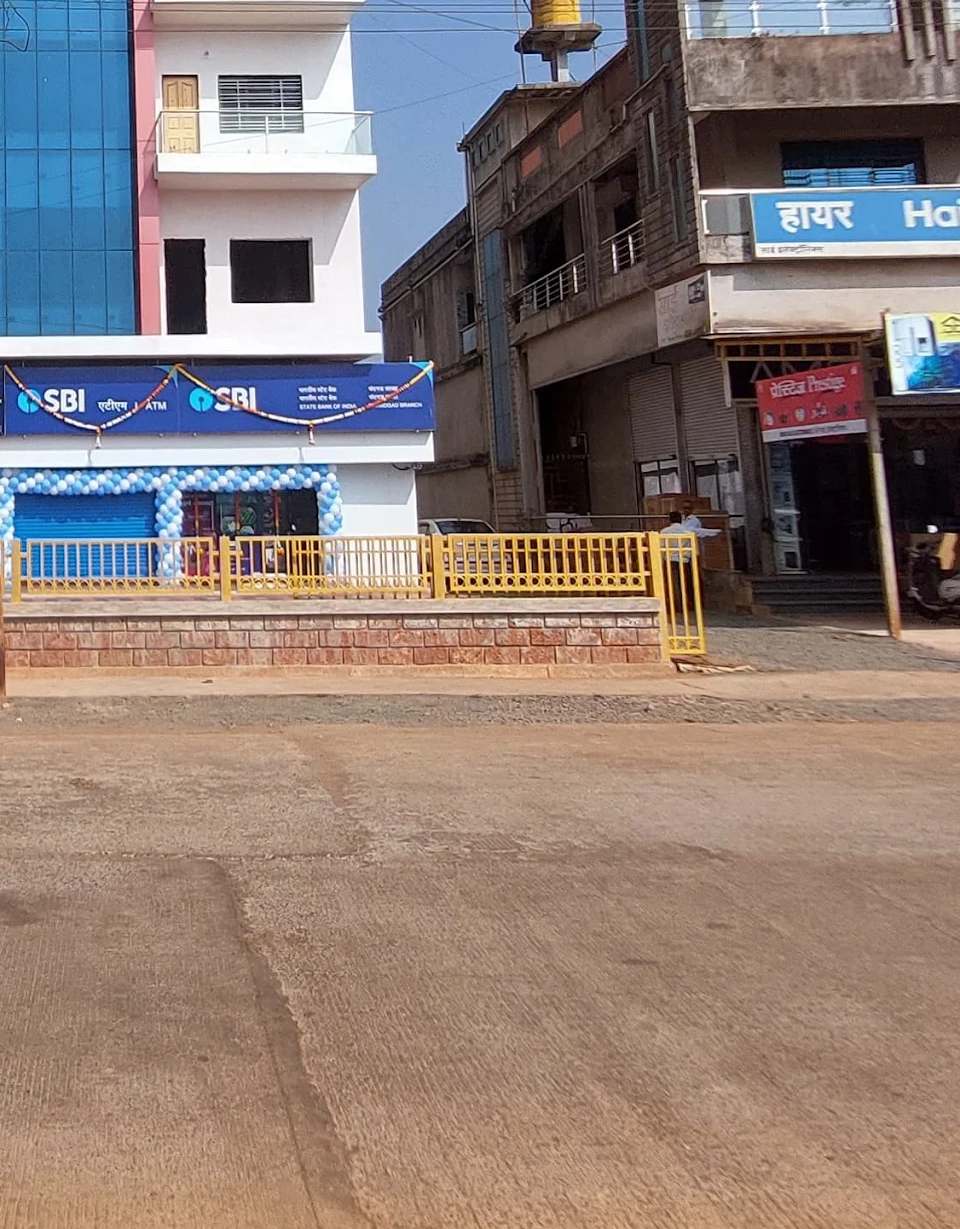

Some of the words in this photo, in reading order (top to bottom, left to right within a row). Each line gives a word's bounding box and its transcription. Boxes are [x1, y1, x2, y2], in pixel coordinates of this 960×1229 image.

[775, 201, 855, 233] हायर
[807, 373, 846, 393] Prestige
[43, 388, 85, 413] SBI
[97, 399, 128, 412] एटीएम
[145, 401, 167, 411] ATM
[213, 386, 257, 412] SBI
